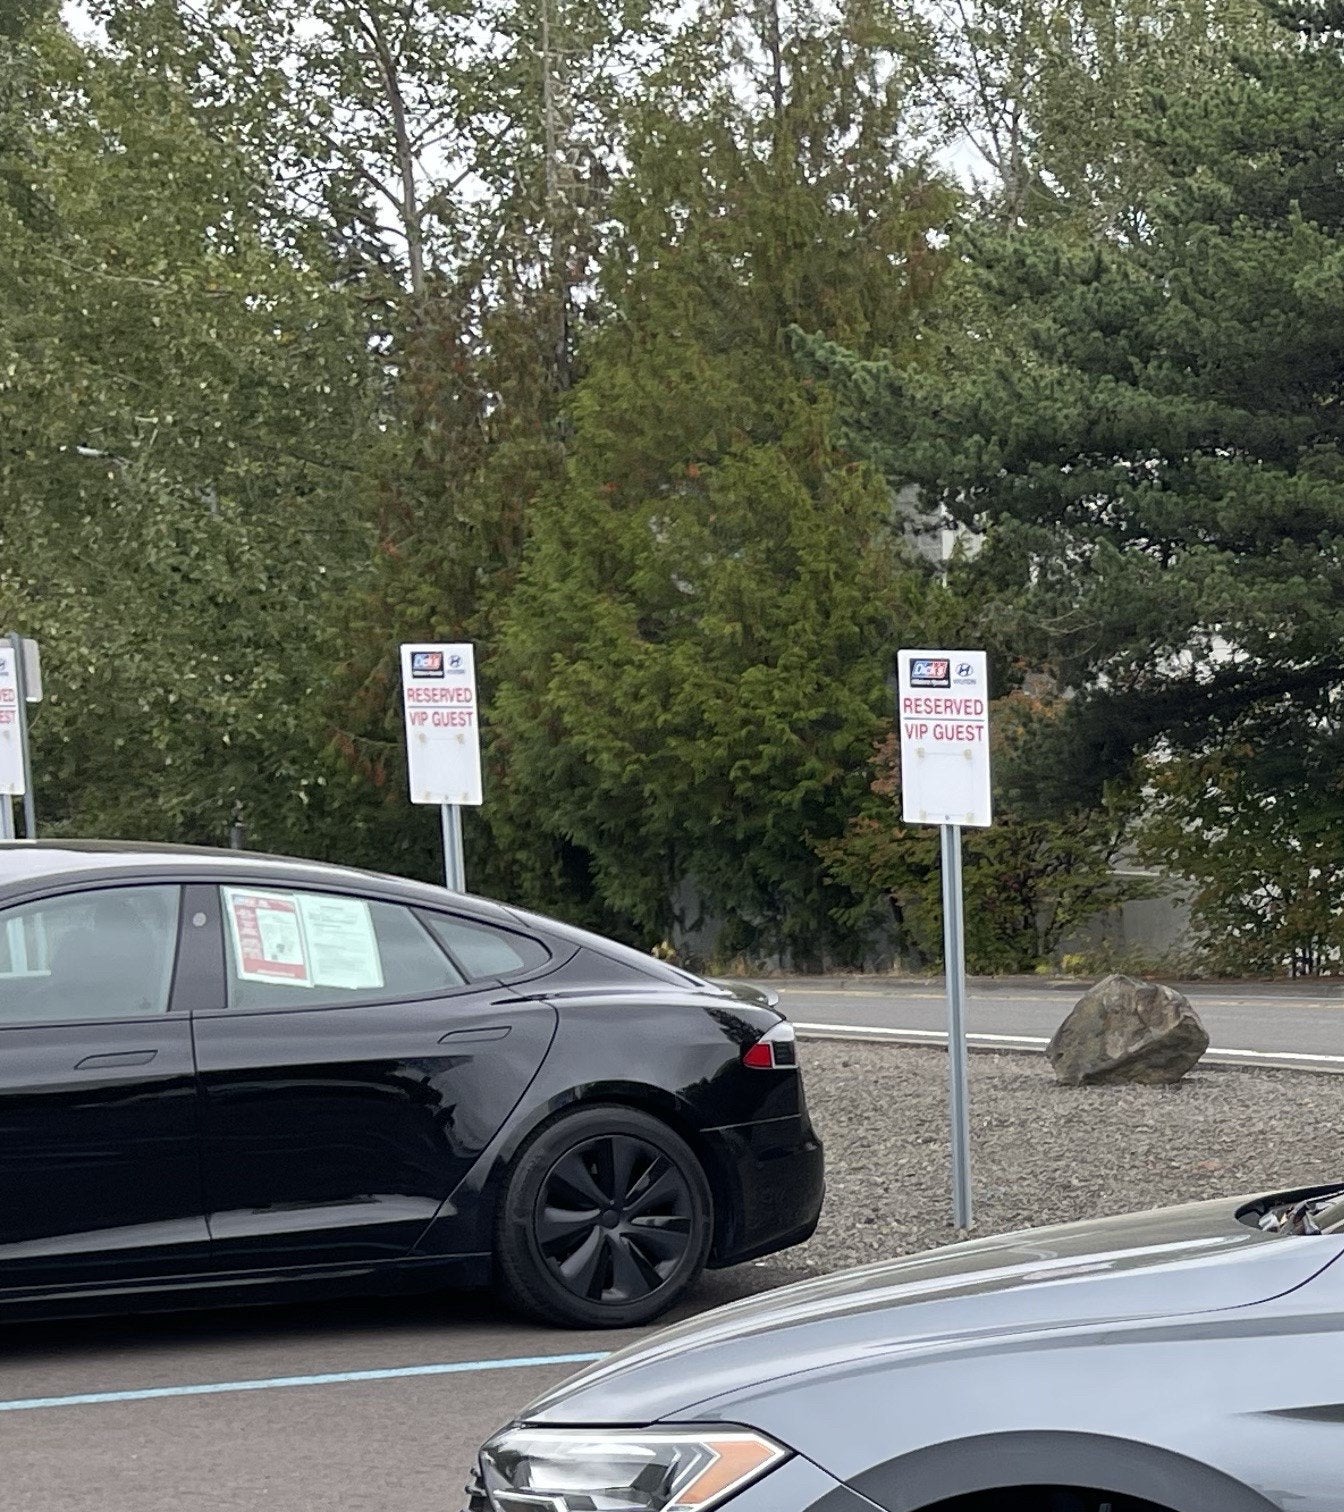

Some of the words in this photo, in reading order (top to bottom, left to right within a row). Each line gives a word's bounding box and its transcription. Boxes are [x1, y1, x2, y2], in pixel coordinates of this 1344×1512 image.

[407, 687, 473, 703] RESERVED
[903, 697, 984, 716] RESERVED
[409, 711, 429, 727] VIP
[432, 711, 473, 728] GUEST
[904, 723, 929, 740] VIP
[933, 723, 984, 742] GUEST
